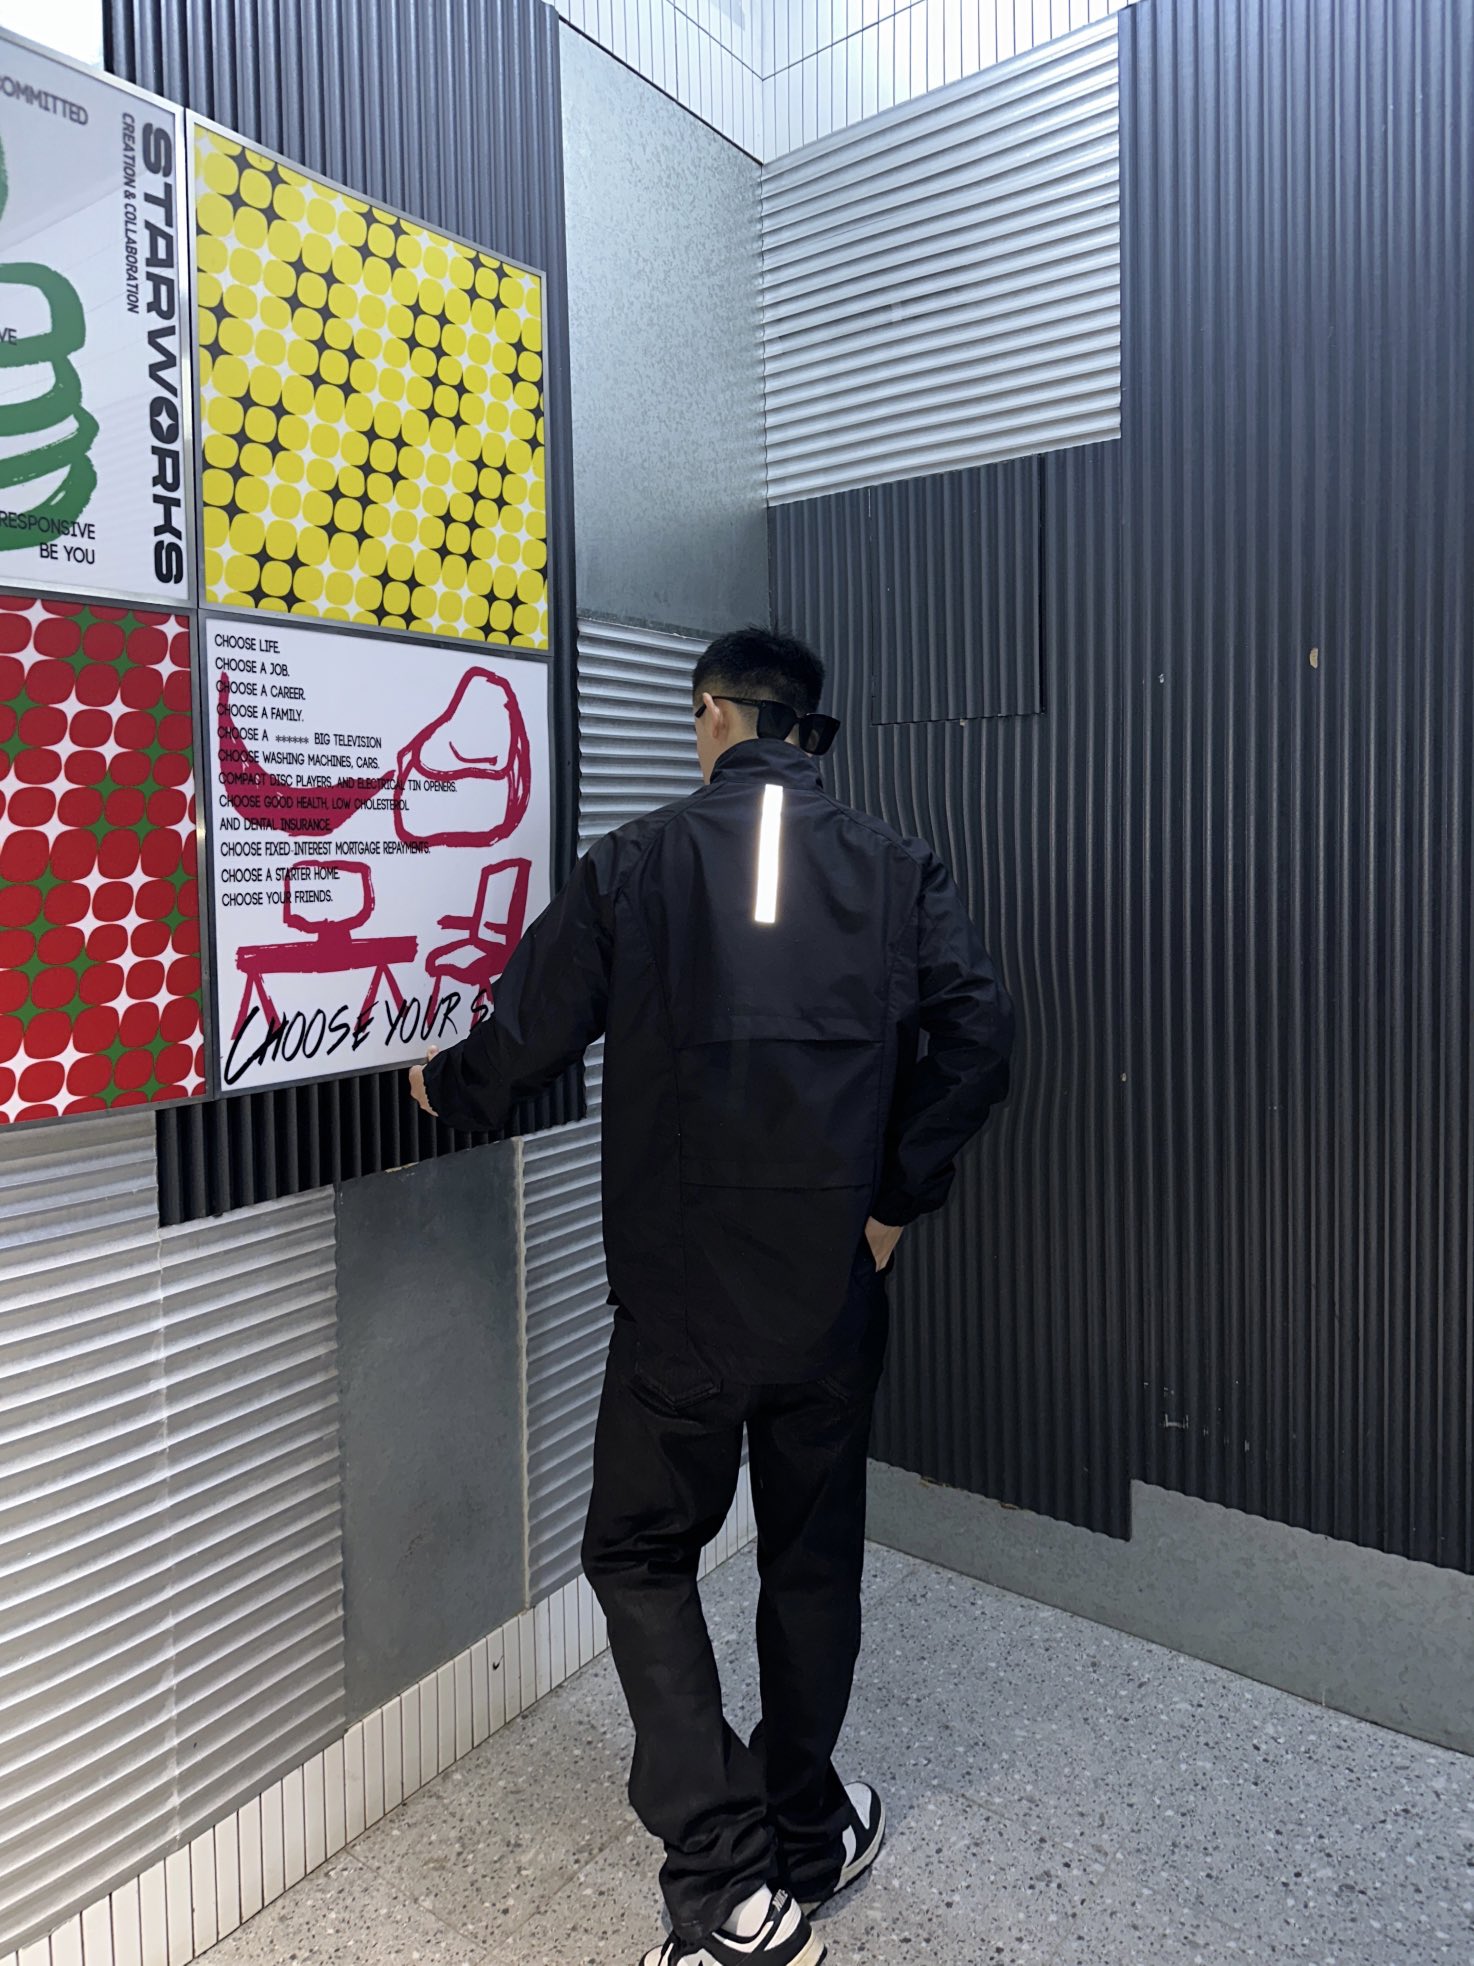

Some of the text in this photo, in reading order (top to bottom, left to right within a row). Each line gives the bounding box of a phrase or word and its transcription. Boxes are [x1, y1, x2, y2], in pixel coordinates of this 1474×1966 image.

[0, 75, 89, 126] OMMITTED
[122, 112, 139, 314] CREATION & COLLABORATION
[142, 122, 184, 585] STARWORKS
[0, 510, 96, 540] RESPONSIVE
[39, 542, 95, 565] BE YOU
[214, 633, 256, 651] CHOOSE
[215, 657, 290, 677] CHOOSE A JOB.
[216, 680, 306, 700] CHOOSE A CAREER.
[216, 703, 304, 722] CHOOSE A FAMILY.
[217, 726, 259, 741] CHOOSE
[261, 729, 269, 742] A
[314, 732, 331, 745] BIG
[333, 733, 382, 749] TELEVISION
[218, 749, 380, 769] CHOOSE WASHING MACHINES, CARS.
[218, 772, 457, 793] COMPACT DISC PLAYERS, AND ELECTRICAL TIN OPENERS.
[219, 794, 261, 809] CHOOSE
[264, 795, 294, 809] GOOD
[332, 797, 351, 810] LOW
[219, 817, 240, 831] AND
[244, 817, 280, 831] DENTAL
[220, 841, 262, 857] CHOOSE
[335, 841, 381, 856] MORTGAGE
[383, 841, 430, 855] REPAYMENTS.
[221, 868, 262, 883] CHOOSE
[265, 867, 272, 882] A
[275, 867, 311, 881] STARTER
[221, 889, 334, 907] CHOOSE YOUR FRIENDS.
[224, 1000, 378, 1085] CHOOSE
[384, 991, 461, 1046] YOUR
